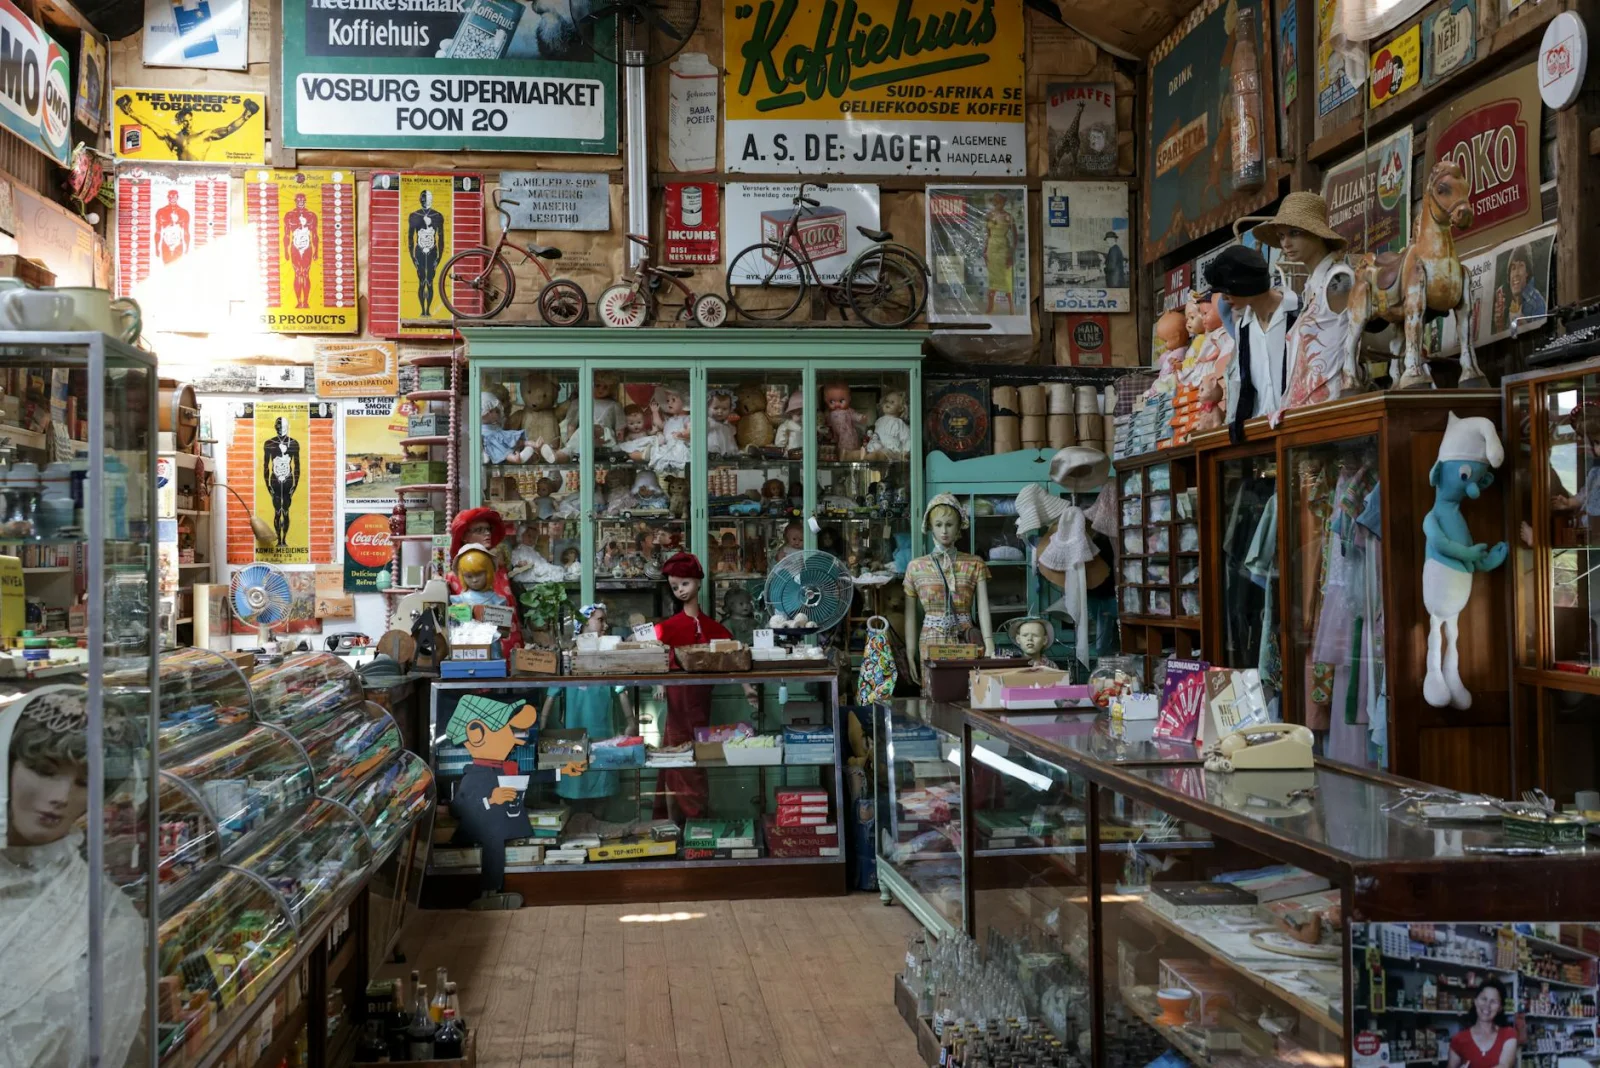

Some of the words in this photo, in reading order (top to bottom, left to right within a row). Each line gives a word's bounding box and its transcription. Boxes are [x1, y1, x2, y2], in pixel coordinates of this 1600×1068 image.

[471, 1, 515, 31] Koffiehuis
[328, 17, 430, 46] Koffiehuis
[1437, 21, 1460, 55] NEHI
[1168, 64, 1193, 96] DRINK
[136, 92, 165, 102] THE
[169, 93, 241, 104] WINNER'S
[302, 77, 420, 102] VOSBURG
[429, 79, 600, 107] SUPERMARKET
[886, 85, 994, 100] SUID-AFRIKA
[1002, 88, 1022, 100] SE
[1050, 88, 1112, 108] GIRAFFE
[46, 80, 68, 128] OMO
[151, 102, 226, 113] TOBACCO.
[689, 106, 712, 115] BABA-
[839, 100, 963, 115] GELIEFKOOSDE
[966, 102, 1023, 117] KOFFIE
[396, 107, 464, 132] FOON
[472, 108, 508, 132] 20
[686, 115, 716, 124] POEIER
[951, 136, 1007, 146] ALGEMENE
[853, 134, 941, 163] JAGER
[947, 152, 1012, 165] HANDELAAR
[1441, 124, 1517, 198] OKO
[532, 202, 577, 211] MASERU
[1476, 184, 1520, 216] STRENGTH
[529, 213, 579, 223] LESOTHO
[1328, 206, 1353, 229] BUILDING
[668, 230, 717, 240] INCUMBE
[1171, 269, 1184, 291] NIE
[1056, 300, 1118, 309] DOLLAR
[279, 315, 346, 325] PRODUCTS
[1078, 333, 1100, 341] LINE
[1, 576, 22, 588] NIVEA
[1218, 704, 1232, 716] NAIL
[1220, 715, 1236, 727] FILE
[613, 848, 644, 856] TOP-NOTCH
